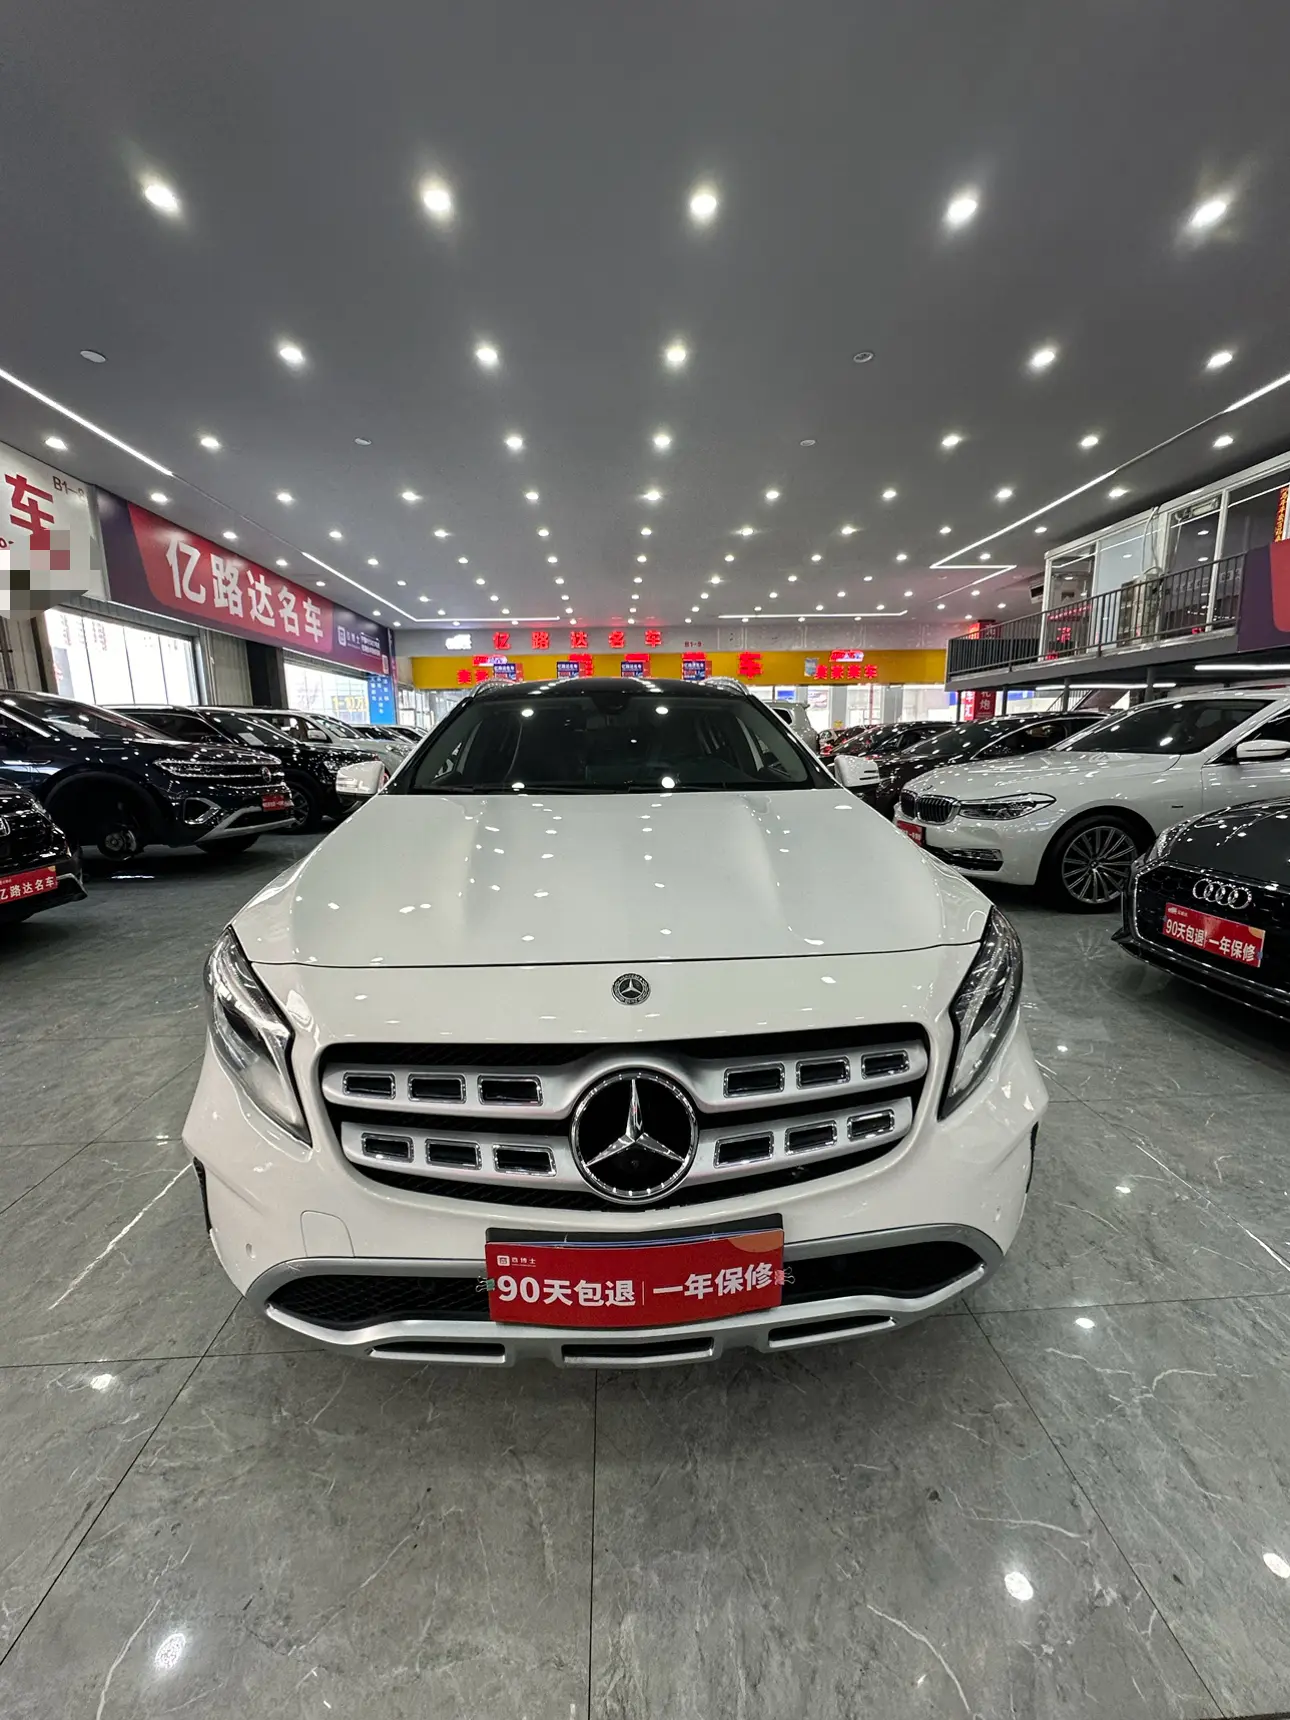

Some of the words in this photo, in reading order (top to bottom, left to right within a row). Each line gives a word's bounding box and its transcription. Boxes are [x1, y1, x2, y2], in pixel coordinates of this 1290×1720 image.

[166, 540, 324, 643] 亿路达名车
[493, 631, 662, 650] 亿路达名车
[1166, 919, 1205, 947] 90天包退
[1209, 936, 1256, 962] 一年保修
[497, 1275, 636, 1307] 90天包退
[653, 1262, 773, 1299] 一年保修
